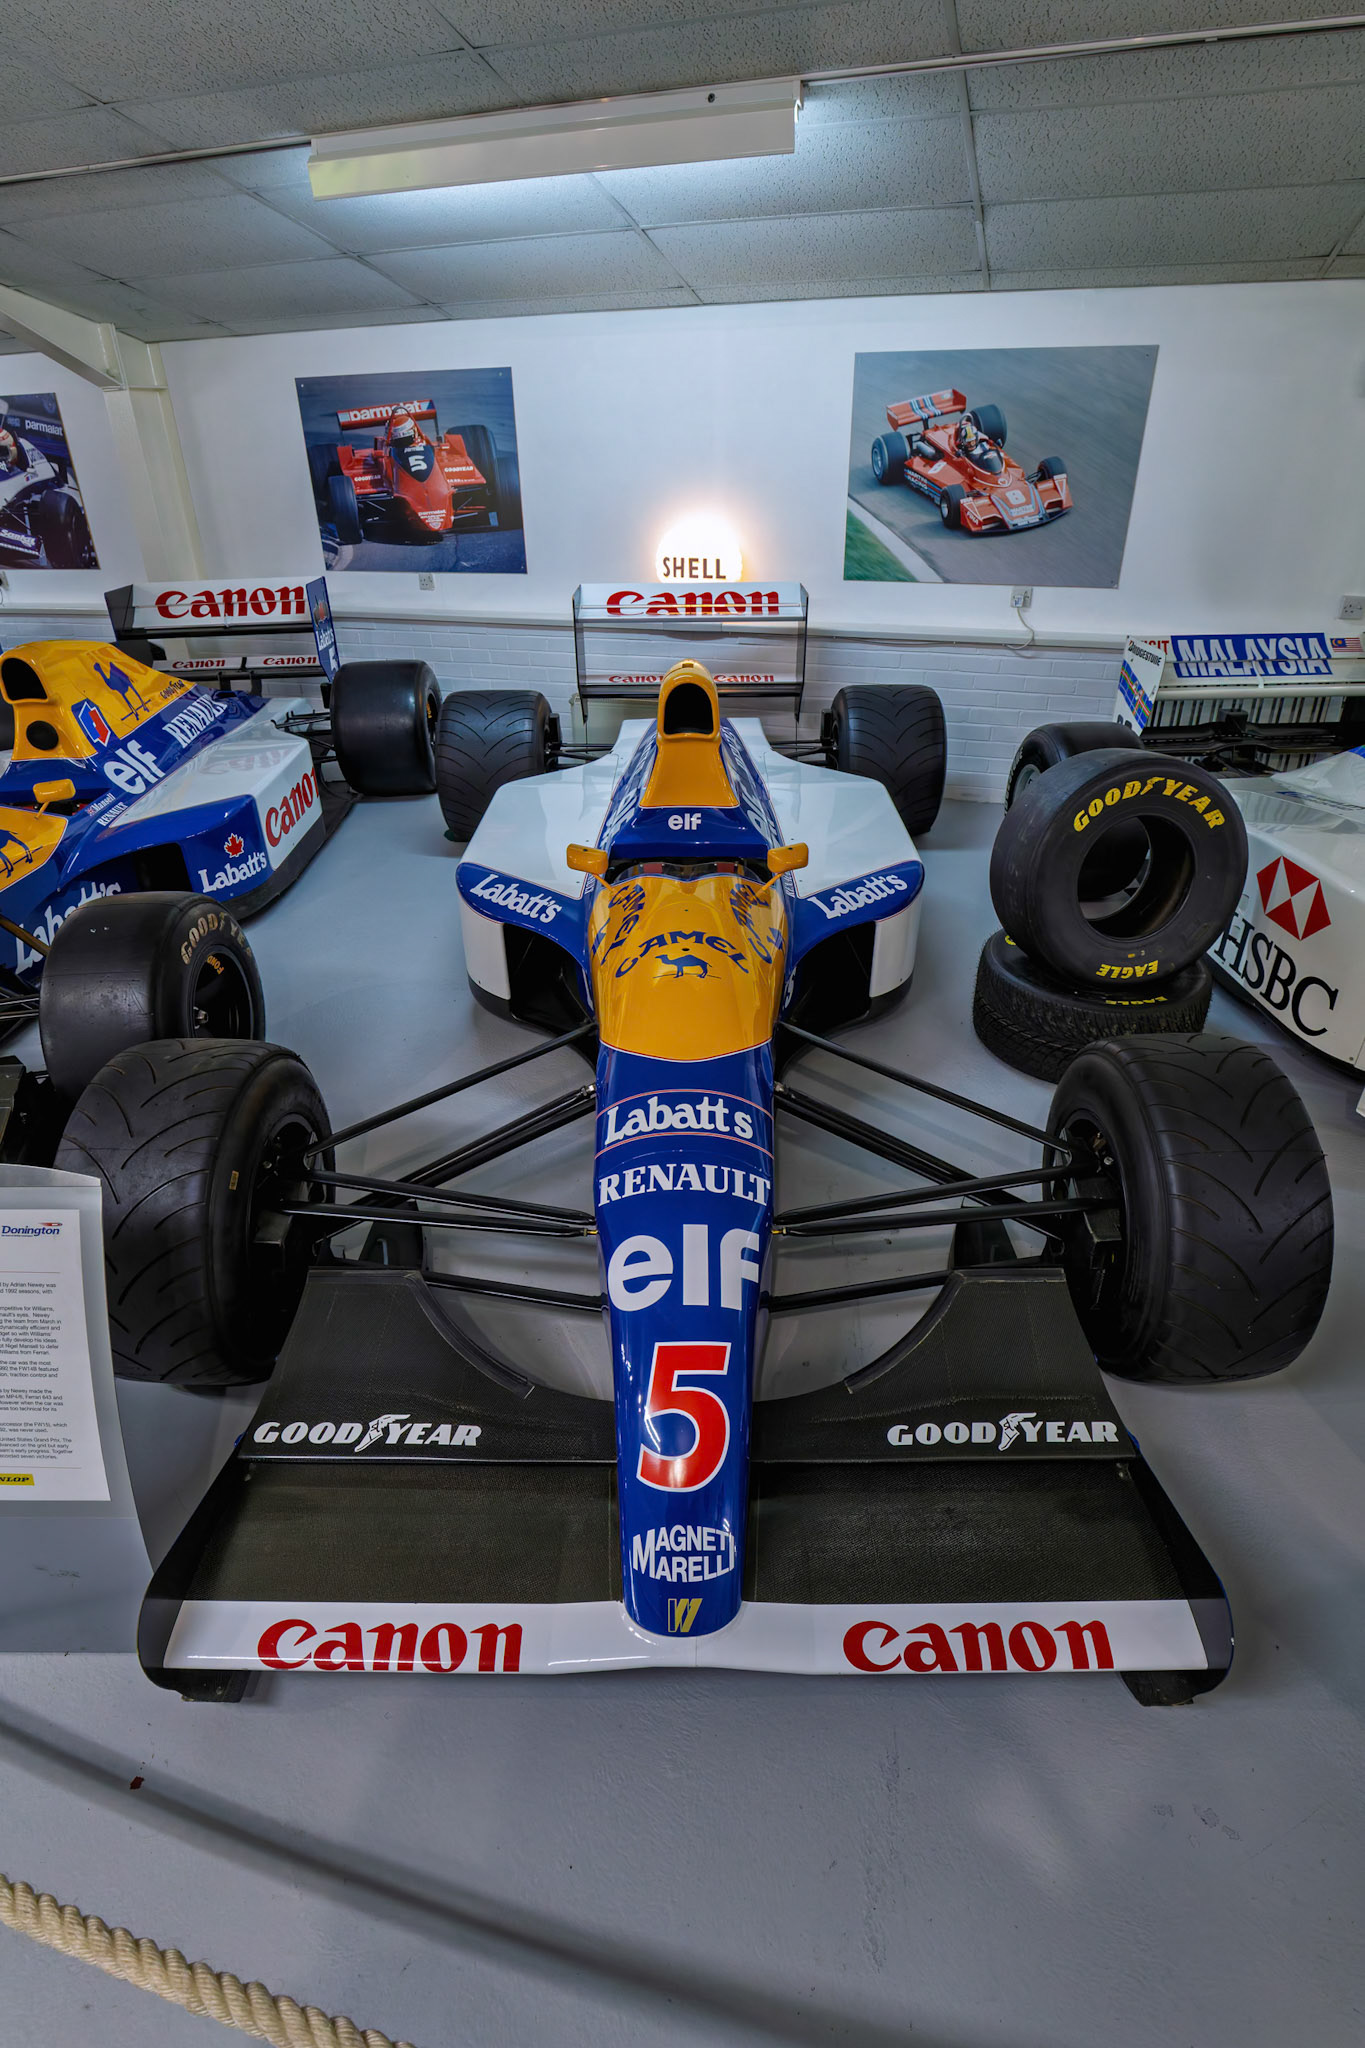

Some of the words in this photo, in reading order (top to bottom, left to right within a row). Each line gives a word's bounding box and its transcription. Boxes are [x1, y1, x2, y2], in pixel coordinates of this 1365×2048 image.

[25, 420, 64, 436] parmalat
[408, 455, 428, 472] 5
[662, 557, 727, 580] SHELL
[154, 586, 305, 619] Canon
[606, 591, 779, 616] Canon
[172, 659, 226, 669] Canon
[263, 656, 317, 666] Canon
[1177, 637, 1331, 676] MALAYSIA
[713, 674, 775, 683] Canon
[161, 694, 228, 749] RENAULT
[104, 739, 166, 795] elf
[96, 802, 128, 827] RENAULT
[667, 812, 702, 831] elf
[198, 851, 267, 894] Labatt's
[469, 874, 562, 925] Labatt's
[805, 874, 908, 920] Labatt's
[615, 931, 750, 978] CAMEL
[1095, 960, 1159, 979] EAGLE
[1212, 912, 1339, 1037] HSBC
[597, 1163, 771, 1207] RENAULT
[1, 1226, 60, 1237] Donington
[607, 1224, 760, 1312] elf
[636, 1342, 732, 1493] 5
[632, 1524, 735, 1560] MAGNETI
[256, 1619, 523, 1673] Canon
[842, 1620, 1114, 1673] Canon
